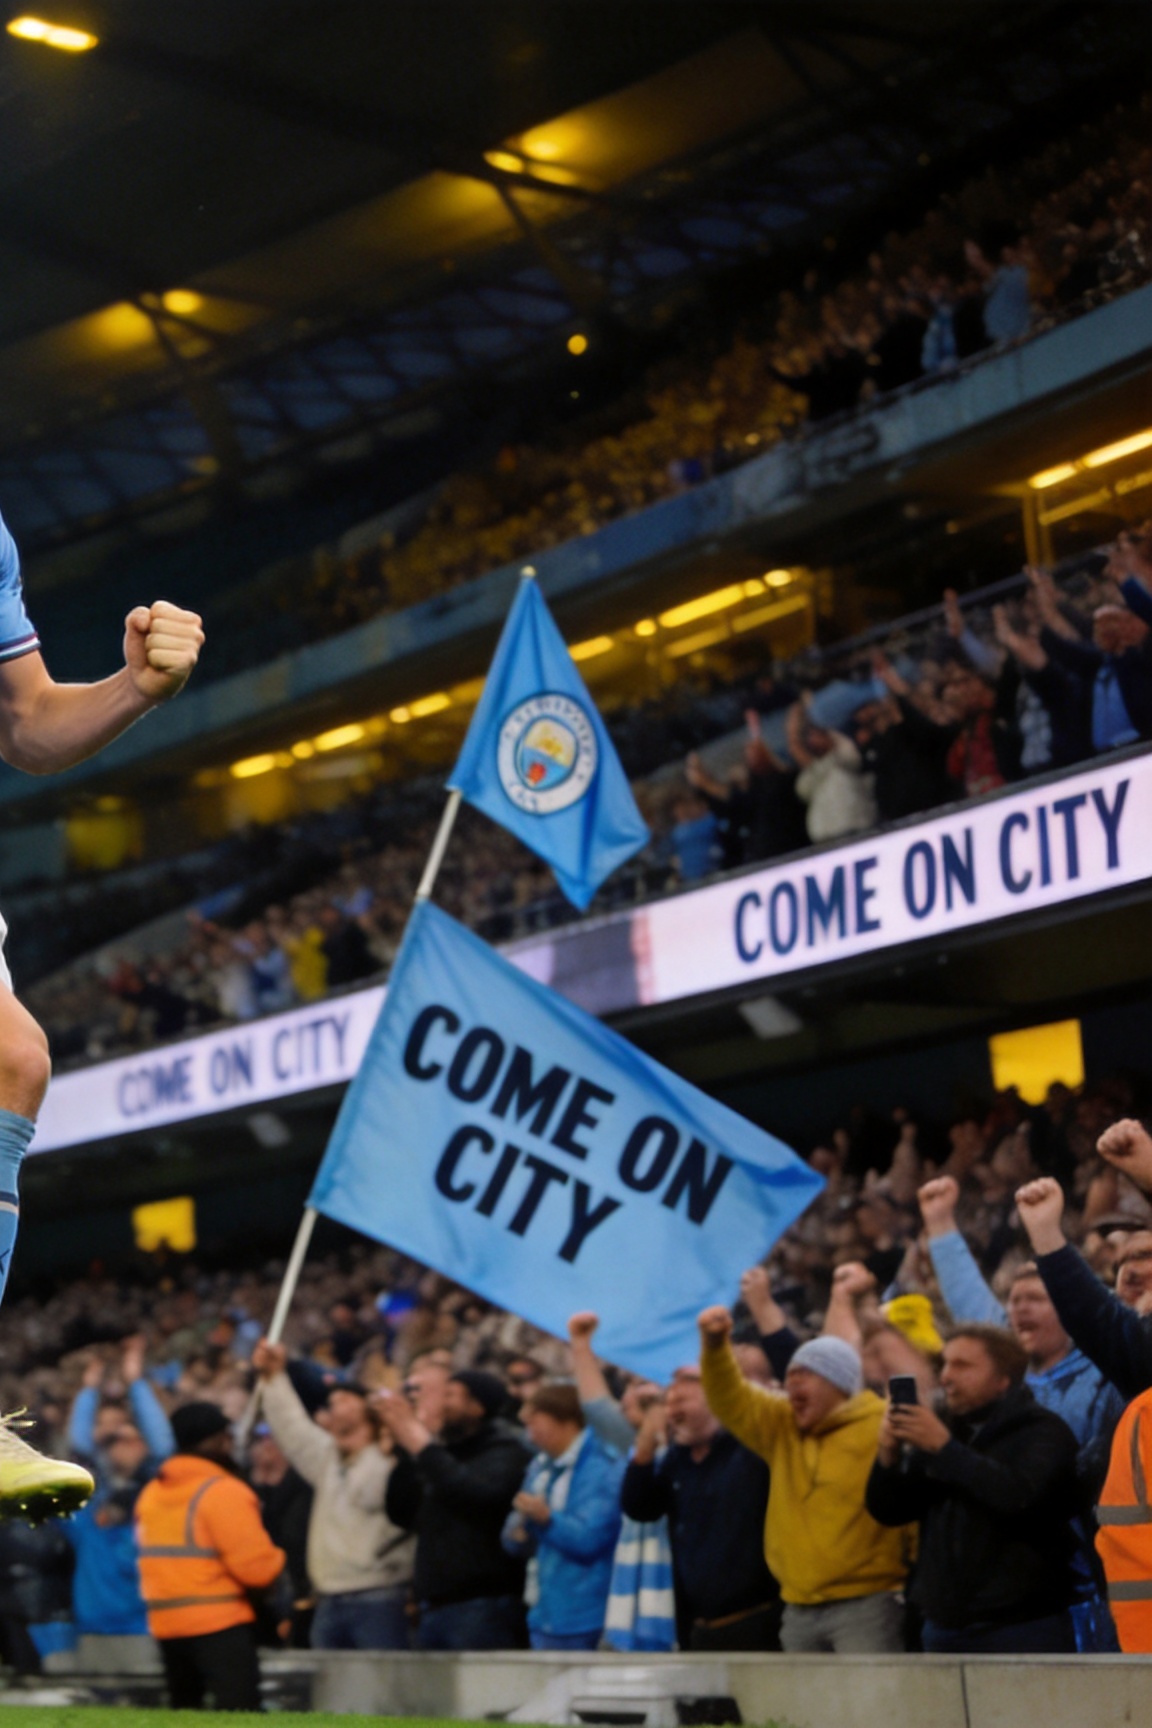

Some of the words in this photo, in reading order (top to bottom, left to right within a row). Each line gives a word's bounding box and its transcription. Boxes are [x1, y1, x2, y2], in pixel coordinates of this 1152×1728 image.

[734, 856, 882, 964] COME
[902, 826, 977, 920] ON
[999, 778, 1131, 895] CITY
[210, 1041, 255, 1096] ON
[273, 1012, 351, 1081] CITY
[403, 1004, 616, 1161] COME
[617, 1115, 737, 1227] ON
[434, 1124, 623, 1265] CITY
